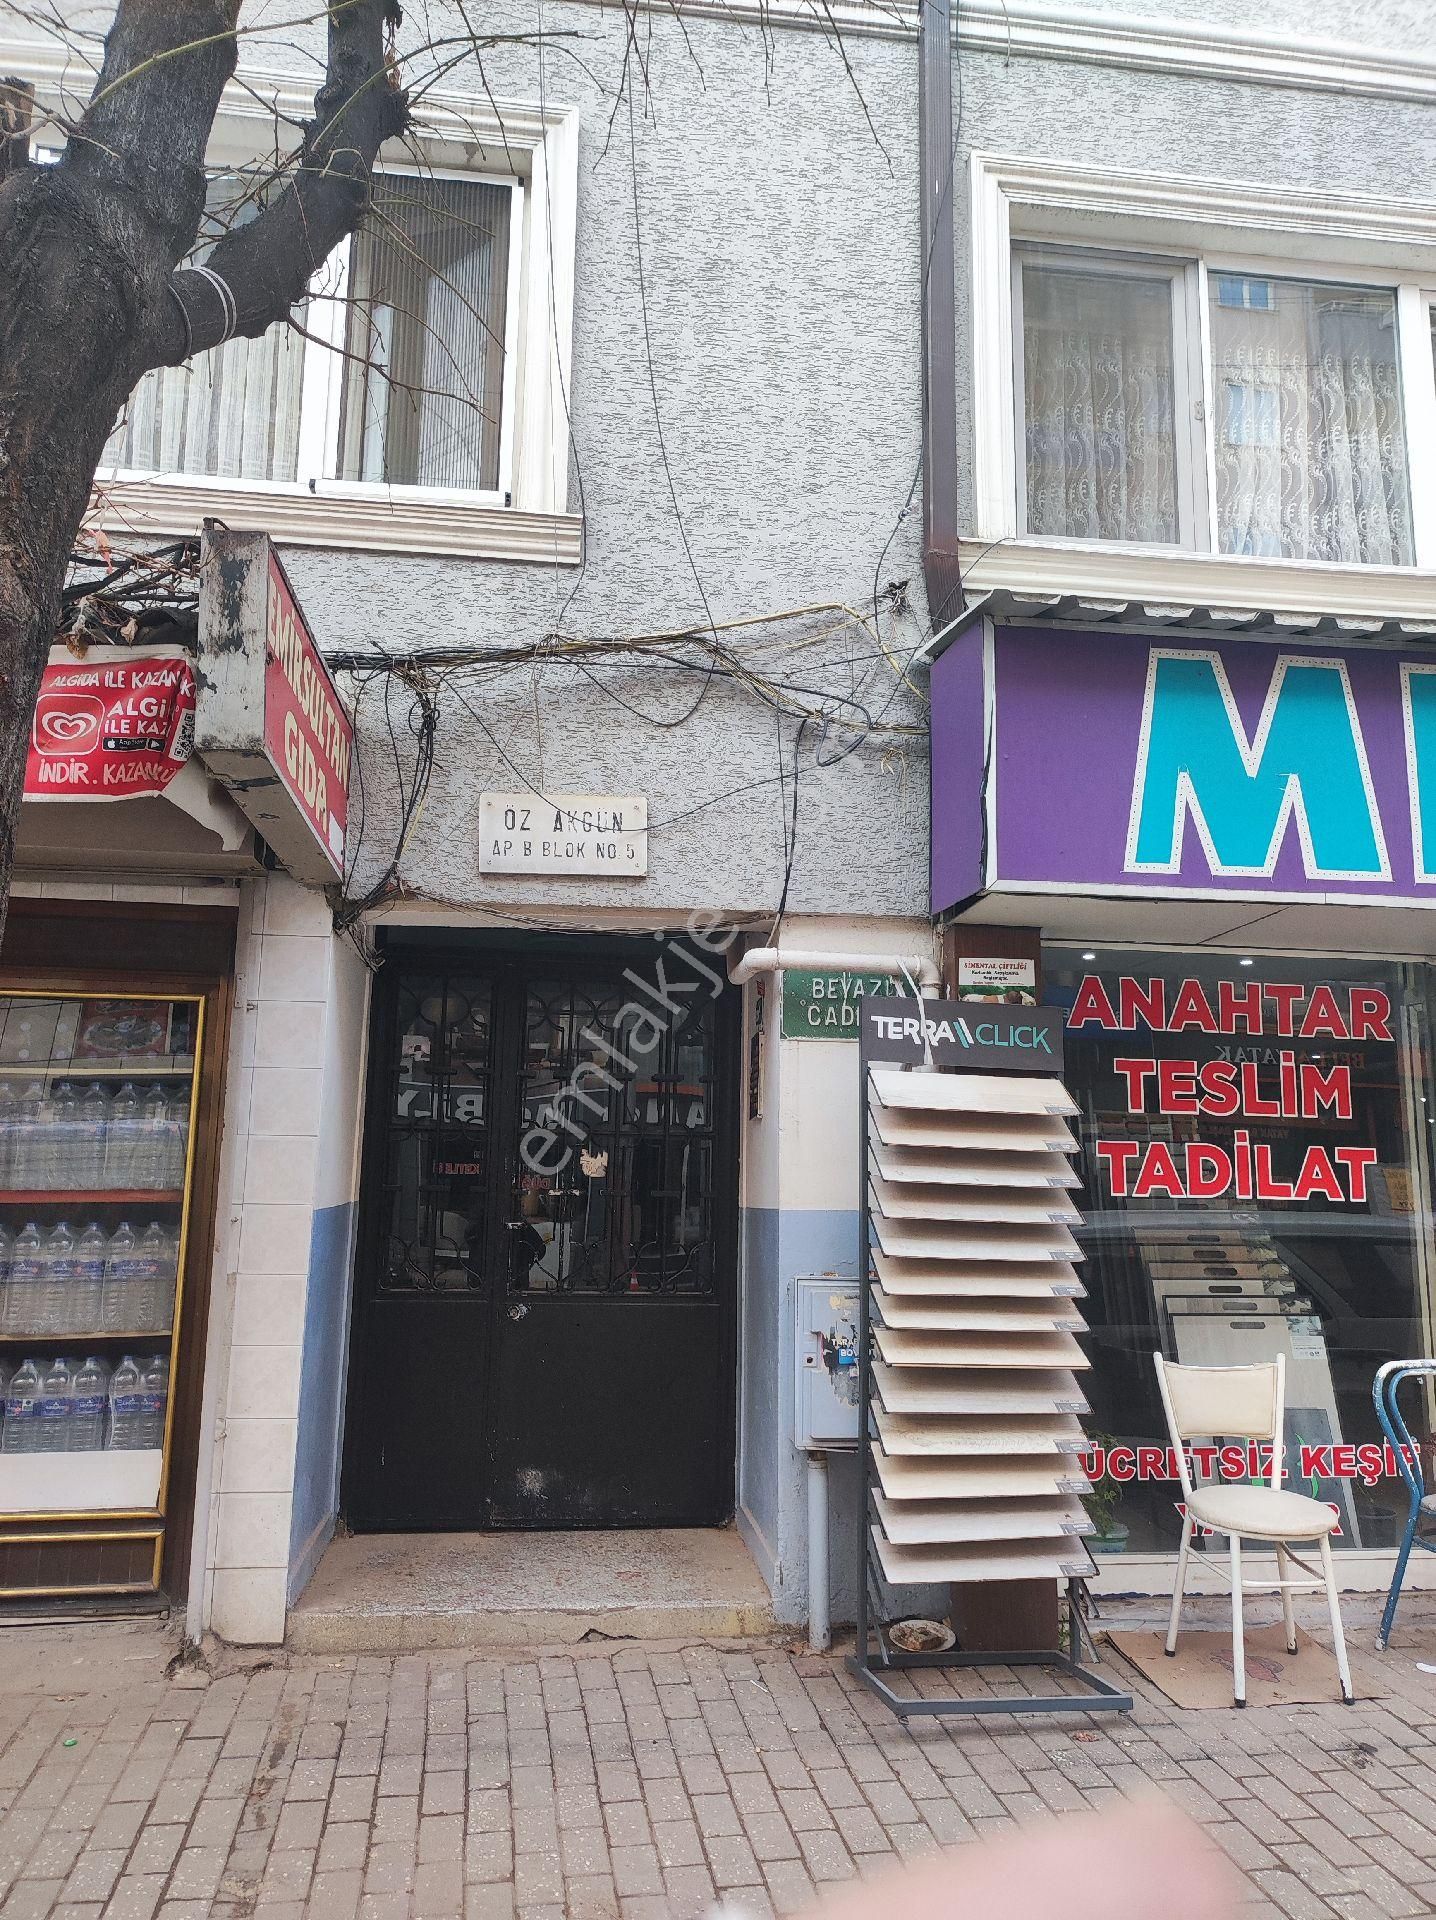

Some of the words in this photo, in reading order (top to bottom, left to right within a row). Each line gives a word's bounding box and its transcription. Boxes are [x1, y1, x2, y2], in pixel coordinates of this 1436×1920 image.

[104, 670, 127, 688] İLE
[104, 719, 130, 734] İLE
[284, 710, 328, 835] GIDA
[504, 803, 531, 831] ÖZ
[523, 840, 532, 857] B
[542, 841, 585, 858] BLOK
[626, 843, 635, 860] 5
[1066, 975, 1395, 1042] ANAHTAR
[1113, 1050, 1353, 1119] TESLİM
[1096, 1129, 1377, 1203] TADİLAT
[1077, 1438, 1289, 1482] ÜCRETSİZ
